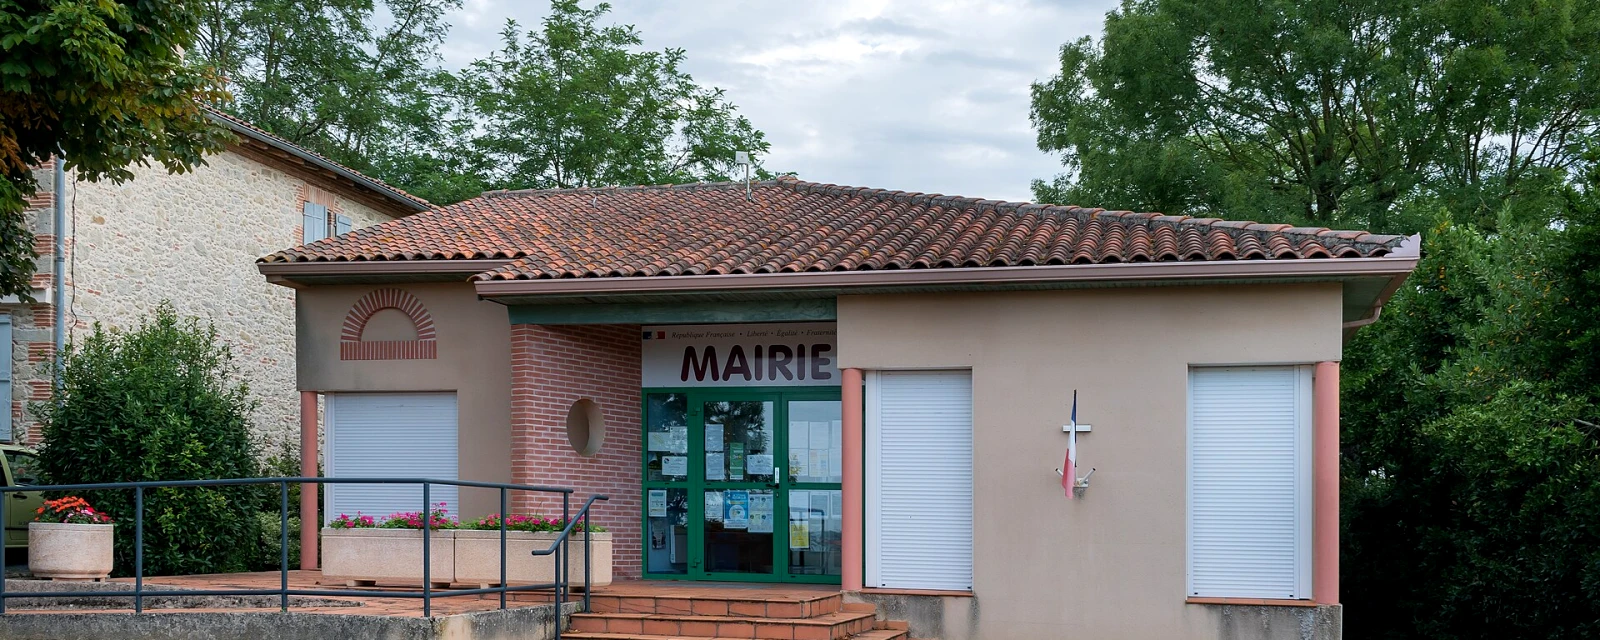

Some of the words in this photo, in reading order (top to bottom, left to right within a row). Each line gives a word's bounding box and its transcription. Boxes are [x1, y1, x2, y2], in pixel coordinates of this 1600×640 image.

[671, 331, 704, 340] République
[705, 331, 735, 339] Française
[776, 329, 798, 337] Égalité
[680, 343, 832, 382] MAIRIE
